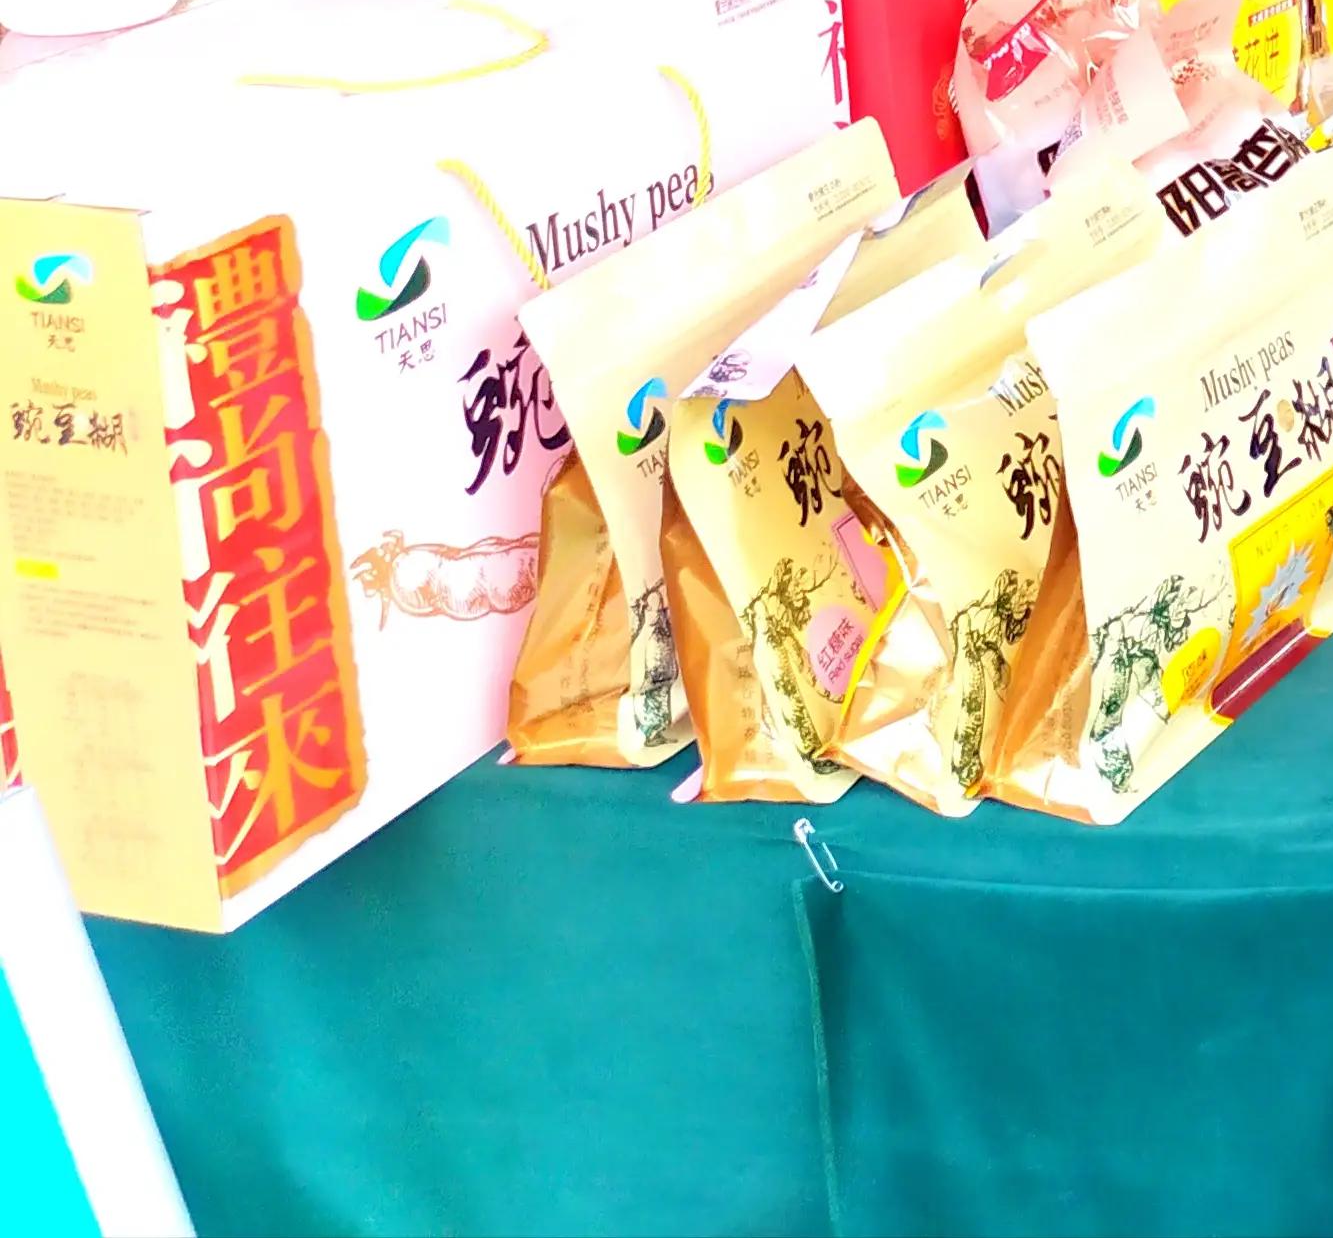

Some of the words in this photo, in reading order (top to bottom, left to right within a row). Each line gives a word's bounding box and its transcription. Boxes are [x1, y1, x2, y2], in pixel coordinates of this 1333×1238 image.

[525, 181, 637, 276] Mushy
[30, 311, 86, 334] TIANSI
[373, 302, 449, 355] TIANSI
[1200, 349, 1259, 417] Mushy
[1257, 324, 1297, 393] peas
[727, 449, 762, 486] TIANSI
[918, 463, 973, 512] TIANSI
[1115, 461, 1160, 503] TIANSI
